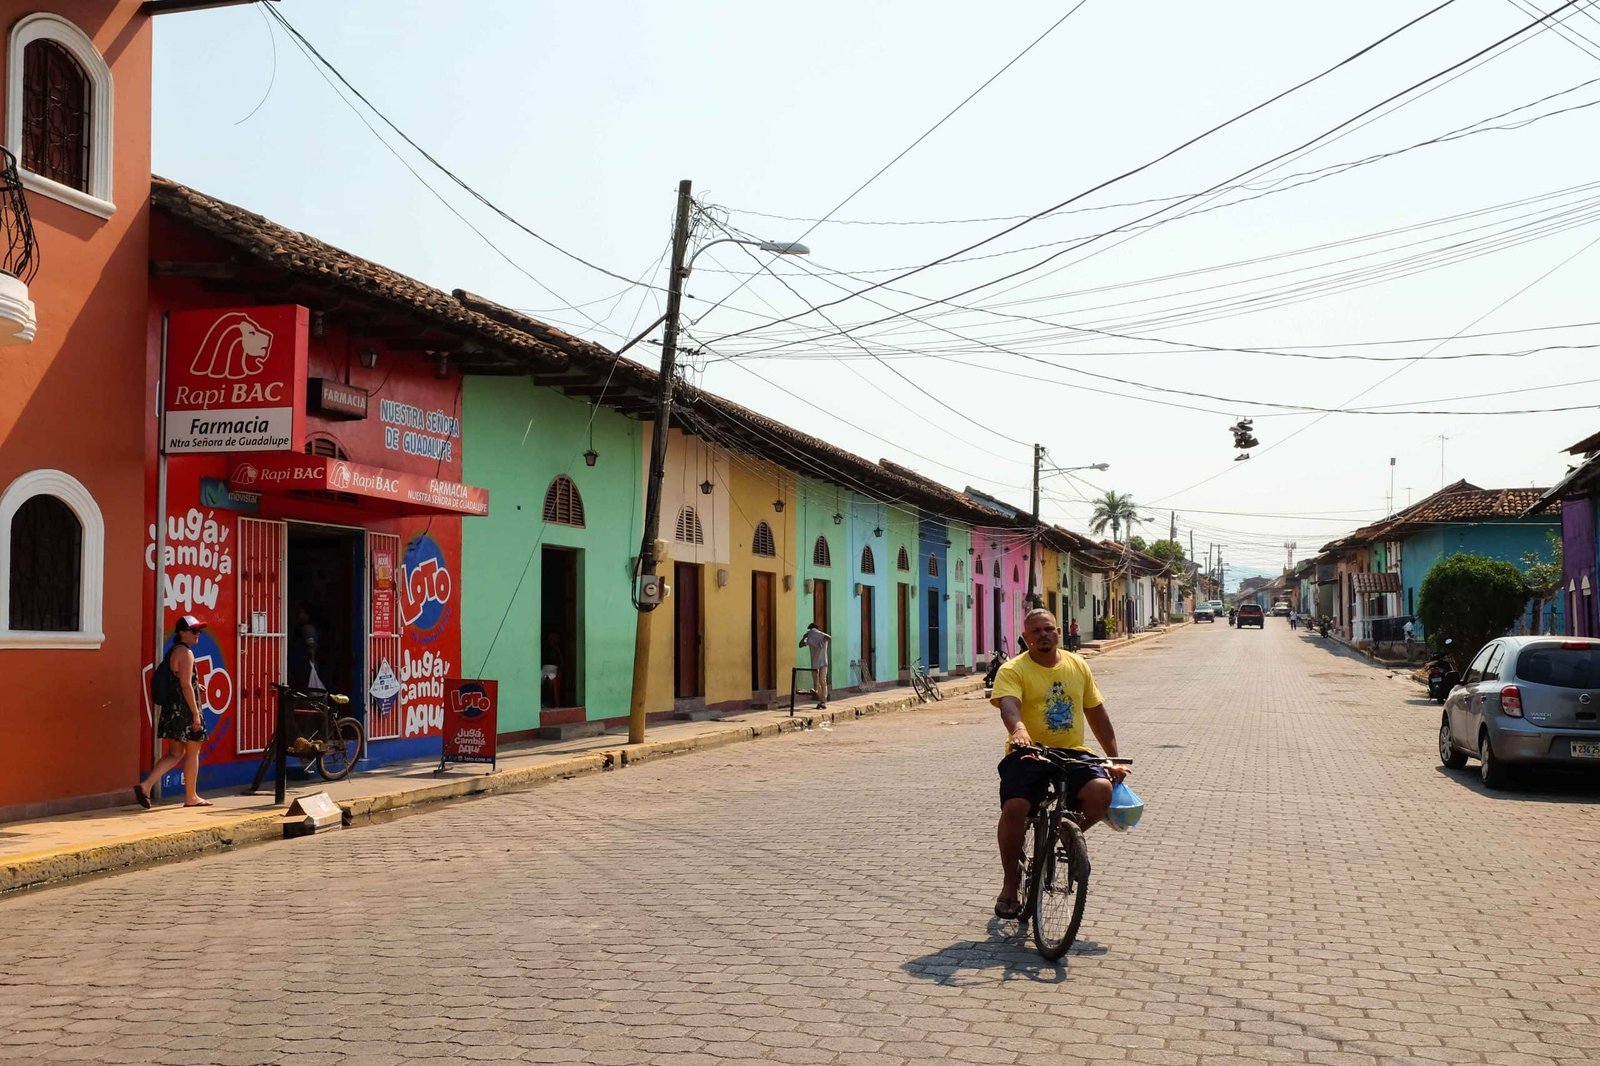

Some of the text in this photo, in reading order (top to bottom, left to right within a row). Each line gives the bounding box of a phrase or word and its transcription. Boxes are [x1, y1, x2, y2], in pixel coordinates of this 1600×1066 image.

[174, 381, 284, 410] Rapi BAC
[323, 388, 366, 409] FARMACIA
[380, 398, 424, 429] NUESTRA
[190, 416, 269, 435] Farmacia
[170, 436, 289, 448] Ntra Señora de Guadalupe
[385, 426, 452, 463] DE GUADALUPE
[261, 467, 325, 483] Rapi BAC
[352, 473, 399, 493] Rapi BAC
[407, 489, 432, 503] NUESTRA
[430, 479, 468, 499] FARMACIA
